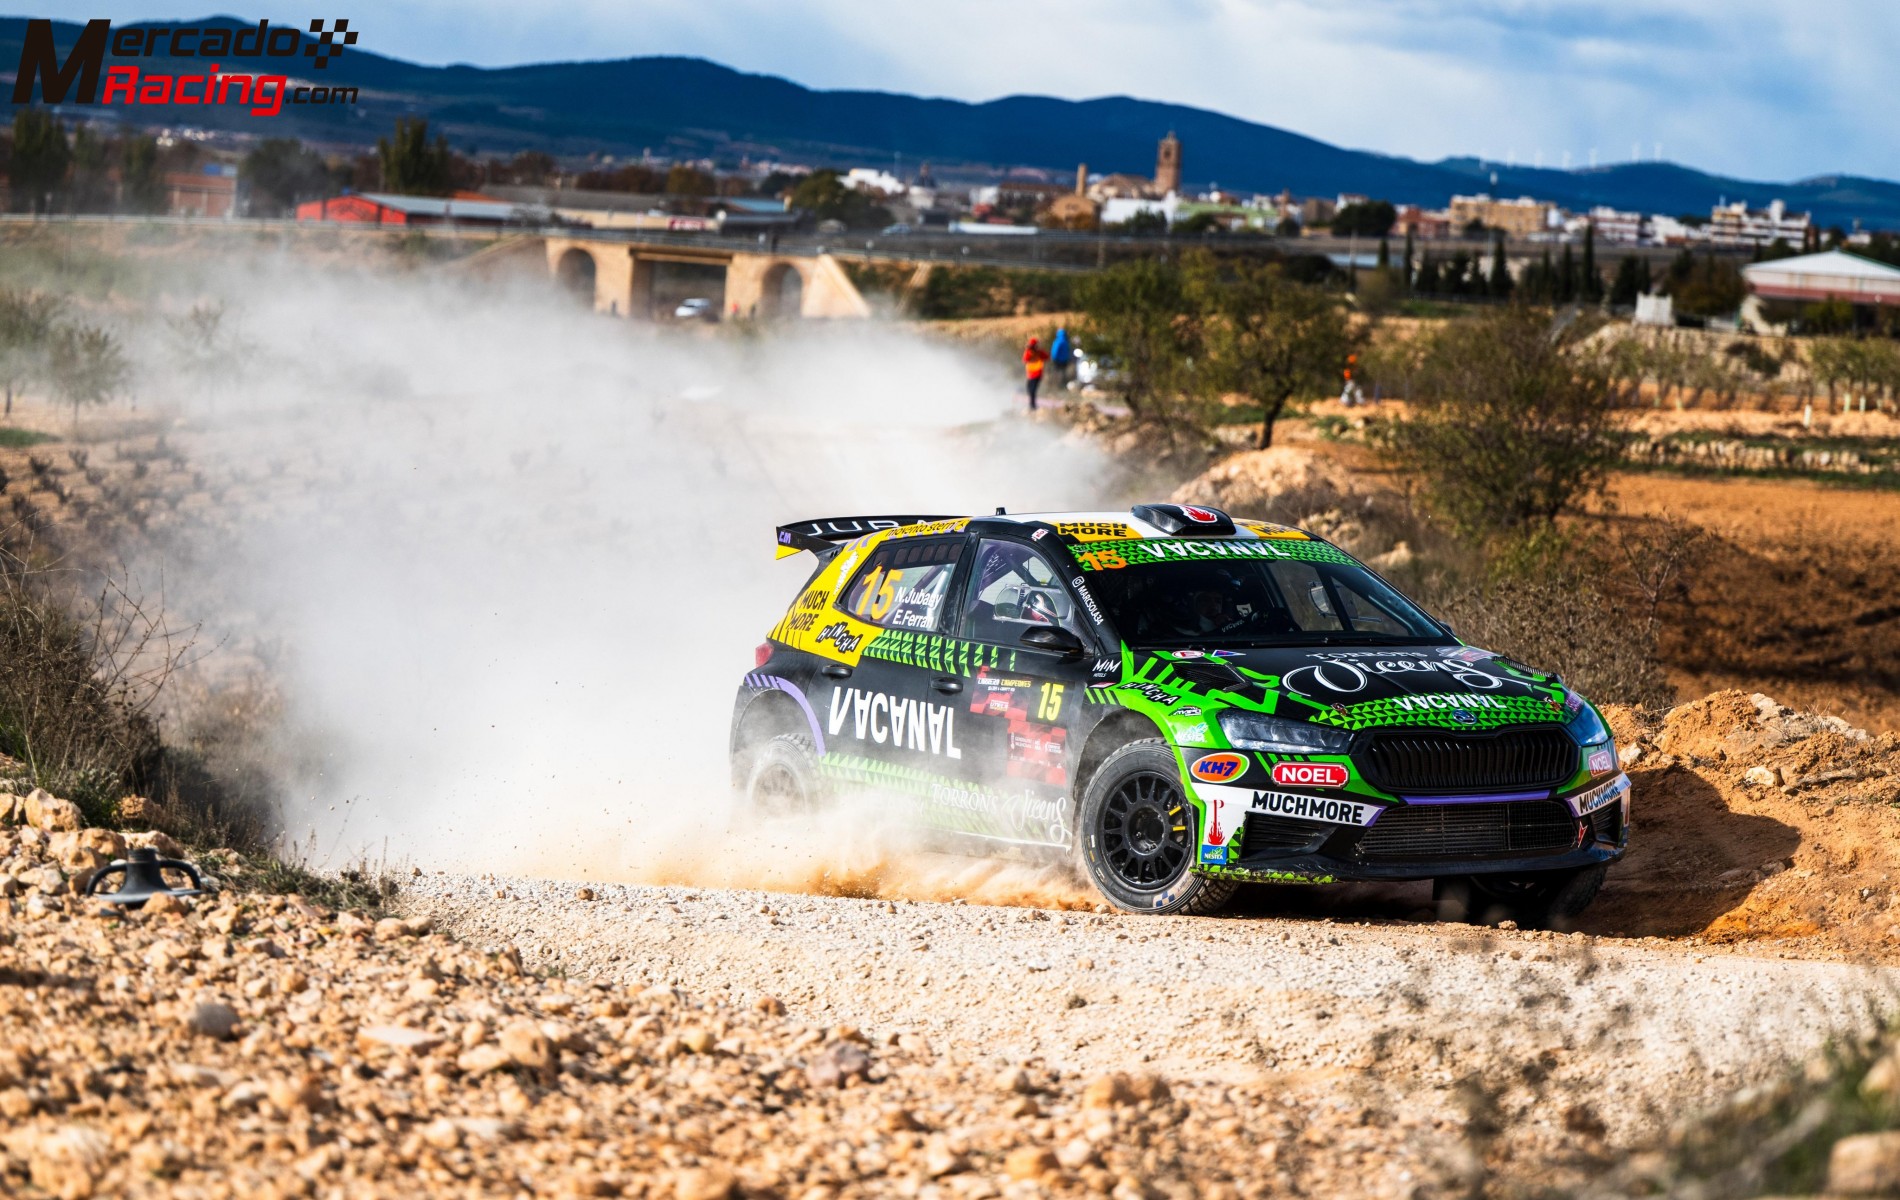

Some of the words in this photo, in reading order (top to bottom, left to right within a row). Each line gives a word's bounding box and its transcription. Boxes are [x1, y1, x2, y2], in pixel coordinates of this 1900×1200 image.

[1056, 528, 1128, 538] MORE
[1058, 521, 1128, 530] MUCH
[1078, 549, 1128, 572] 15
[799, 590, 830, 610] MUCH
[855, 565, 904, 620] 15
[785, 612, 820, 632] MORE
[816, 623, 862, 653] HINCHA
[1037, 682, 1065, 721] 15
[1120, 681, 1179, 706] HINCHA
[1391, 693, 1508, 711] VACANAL
[828, 686, 962, 760] VACANAL
[1281, 767, 1338, 784] NOEL
[1590, 756, 1612, 773] NOEL
[930, 782, 999, 815] TORRONS
[1251, 790, 1365, 825] MUCHMORE
[1578, 778, 1621, 815] MUCHMORE
